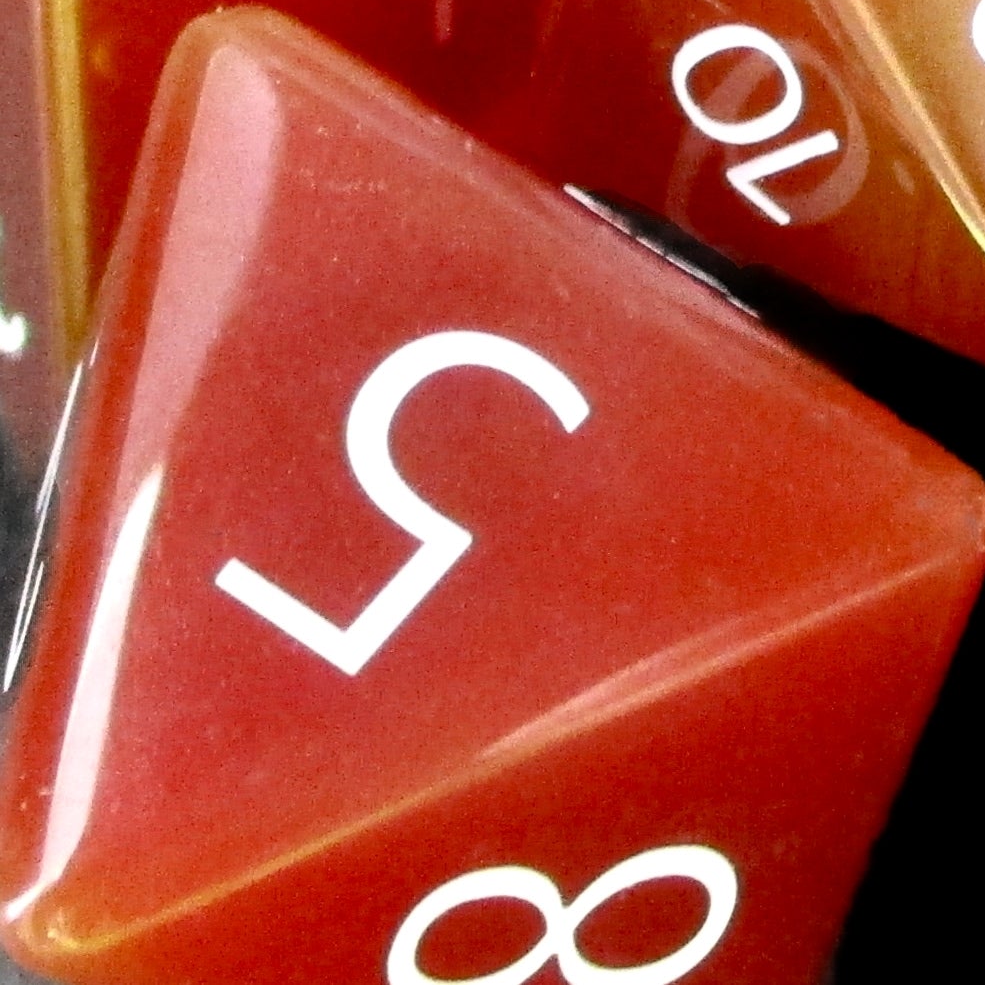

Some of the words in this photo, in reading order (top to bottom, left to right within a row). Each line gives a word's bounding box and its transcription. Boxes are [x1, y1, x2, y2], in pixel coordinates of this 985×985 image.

[671, 23, 840, 226] 10
[213, 329, 591, 677] 5
[386, 844, 739, 985] 8
